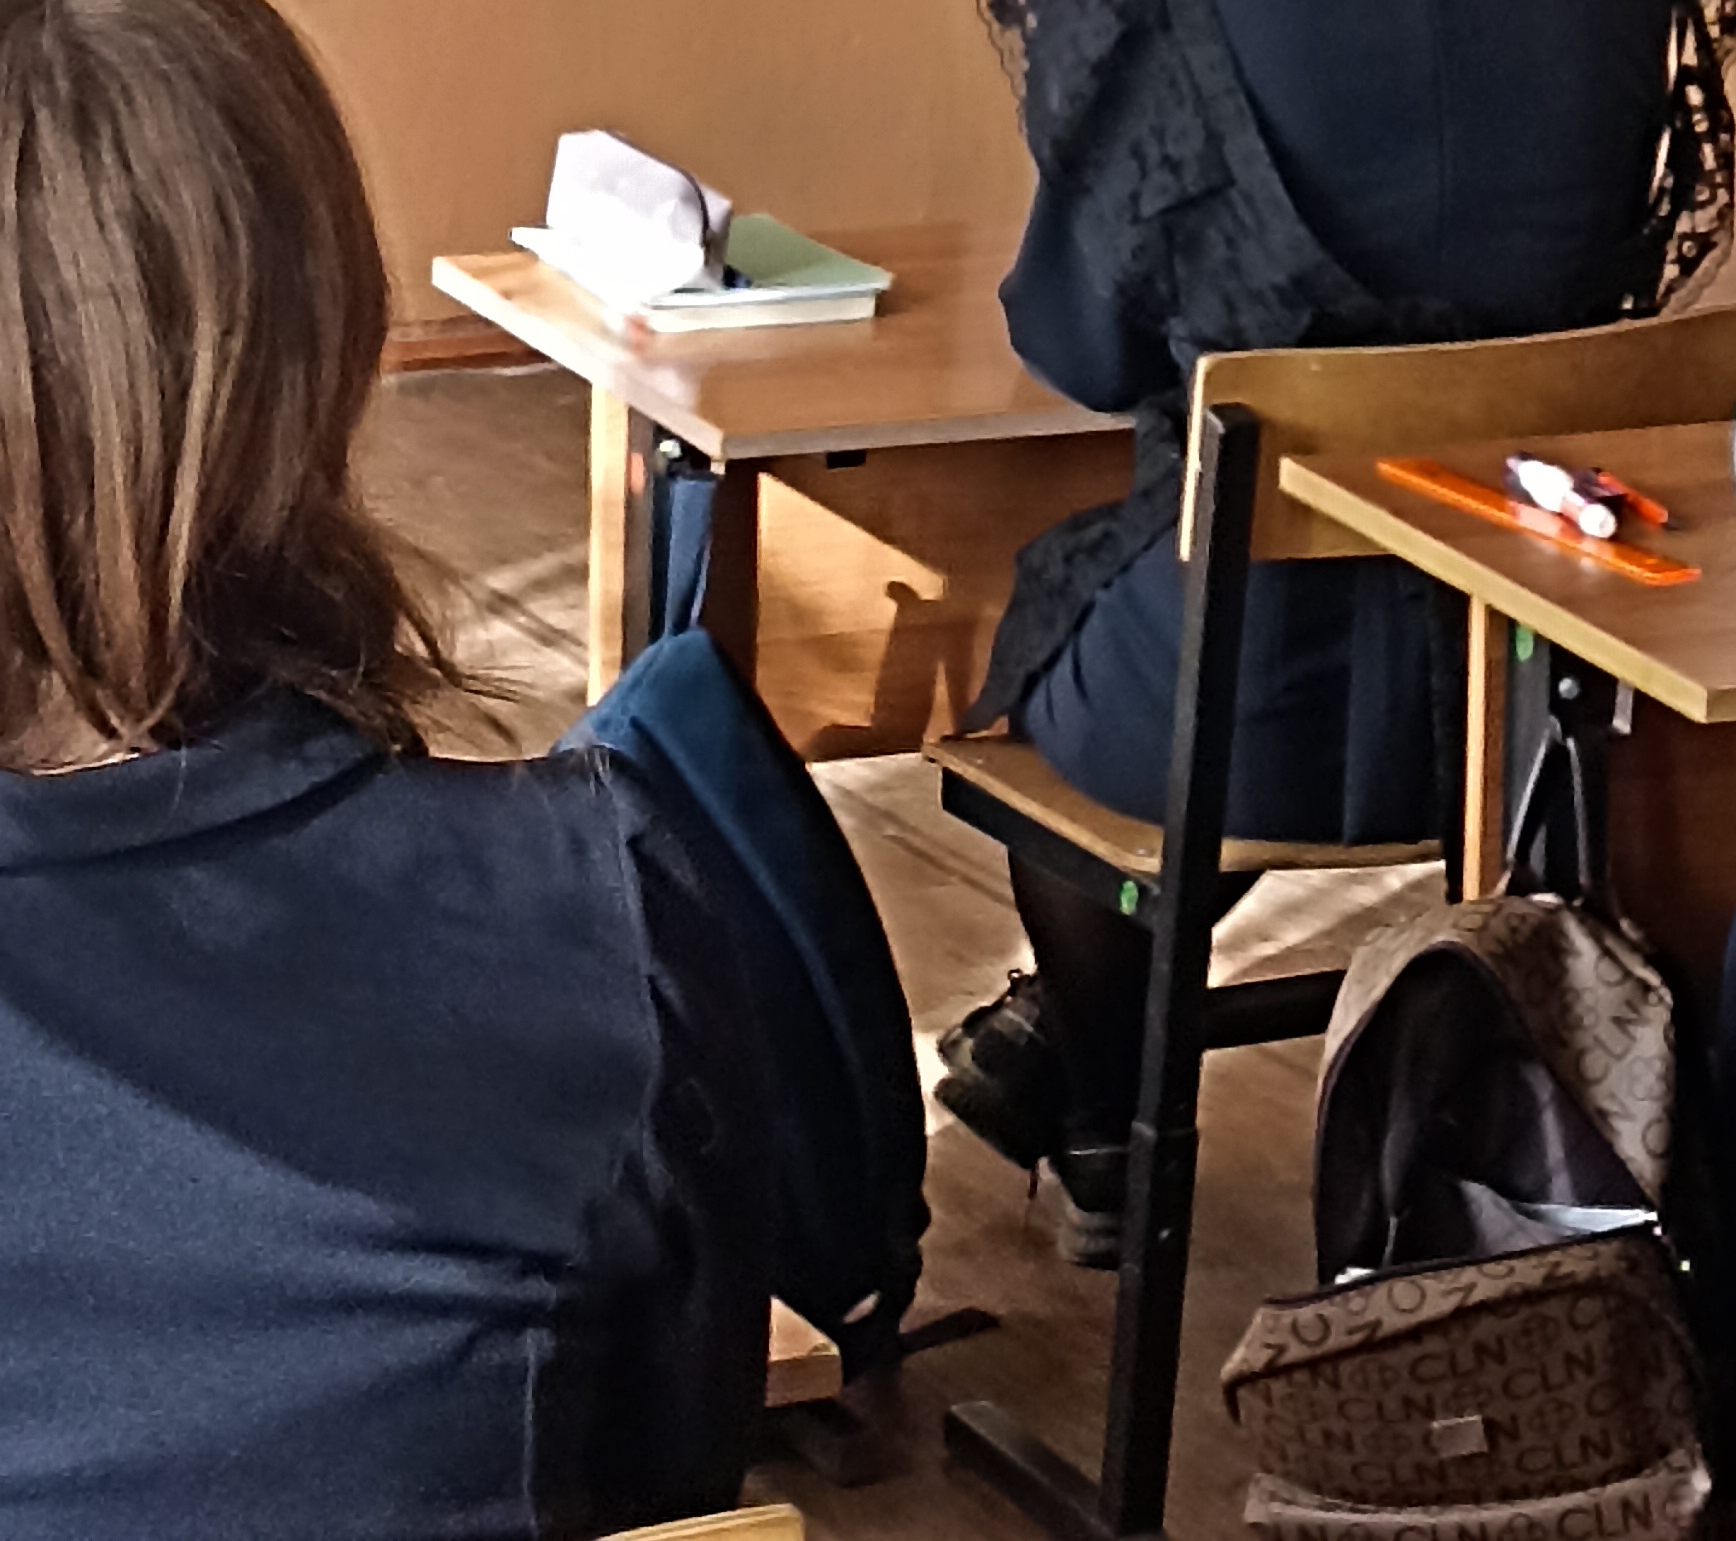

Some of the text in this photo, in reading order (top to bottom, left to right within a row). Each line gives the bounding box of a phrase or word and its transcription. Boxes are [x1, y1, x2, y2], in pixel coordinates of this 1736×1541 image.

[1409, 1335, 1507, 1385] CLN
[1502, 1339, 1596, 1401] CLN
[1515, 1426, 1614, 1476] CLN
[1556, 1492, 1654, 1540] CLN
